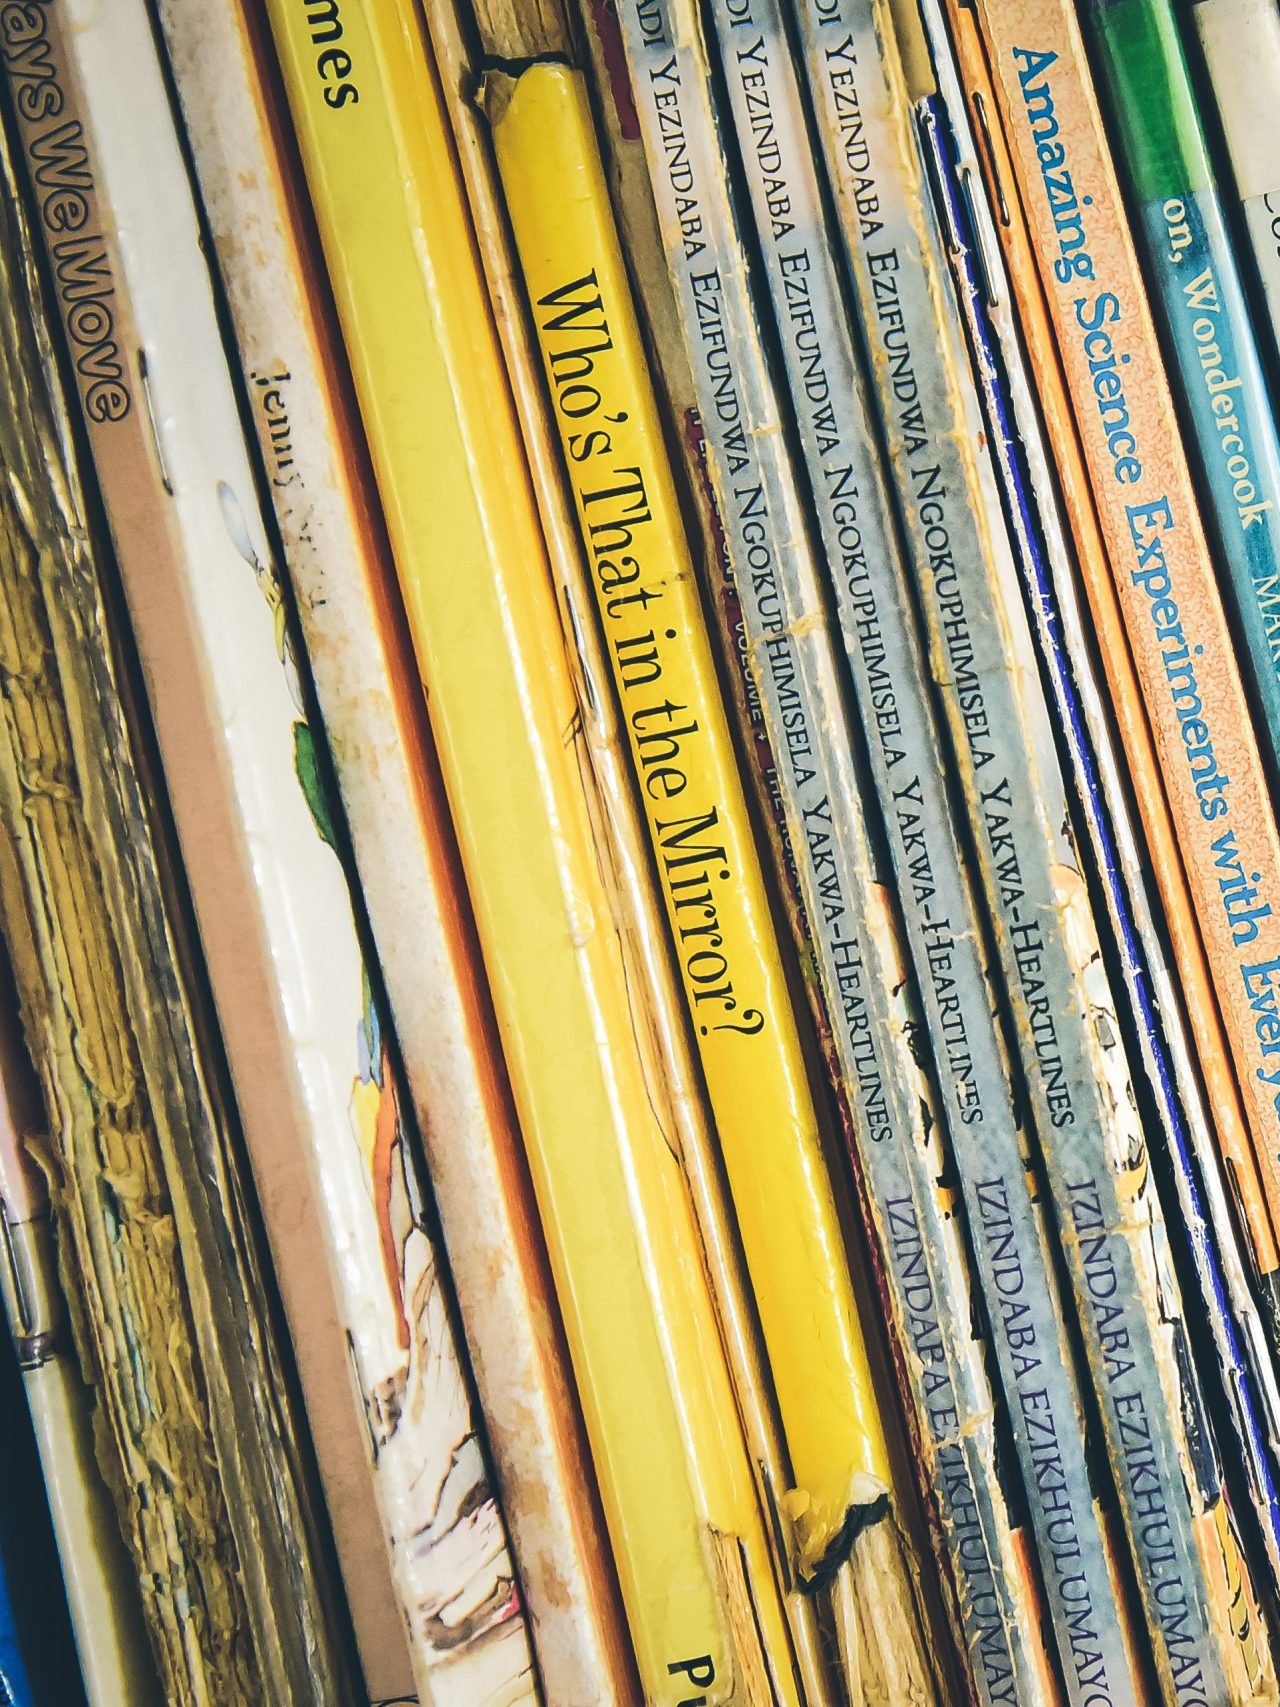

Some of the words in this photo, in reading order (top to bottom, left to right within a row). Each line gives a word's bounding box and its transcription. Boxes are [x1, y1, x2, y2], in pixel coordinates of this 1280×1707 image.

[0, 0, 64, 123] ays
[303, 0, 358, 108] mes
[28, 119, 93, 233] We
[50, 234, 131, 423] Move
[536, 267, 628, 461] Who's
[1183, 267, 1267, 531] Wondercook
[579, 466, 666, 618] That
[648, 54, 706, 261] YEZINDABA
[689, 267, 749, 476] EZIFUNDWA
[733, 482, 816, 787] NGOKUPHIMISELA
[801, 794, 892, 1142] YAKWA-HEARTLINES
[735, 35, 795, 241] YEZINDABA
[777, 247, 840, 456] EZIFUNDWA
[823, 463, 906, 769] NGOKUPHIMISELA
[891, 774, 983, 1124] YAKWA-HEARTLINES
[824, 33, 883, 240] YEZINDABA
[866, 247, 928, 456] EZIFUNDWA
[910, 463, 995, 770] NGOKUPHIMISELA
[979, 777, 1074, 1127] YAKWA-HEARTLINES
[1012, 47, 1096, 284] Amazing
[1073, 292, 1142, 484] Science
[1124, 496, 1230, 821] Experiments
[1210, 830, 1272, 946] with
[614, 628, 676, 691] in
[631, 699, 698, 800] the
[654, 805, 764, 1036] Mirror?
[884, 1193, 951, 1397] IZINDABA
[973, 1175, 1042, 1380] IZINDABA
[1065, 1177, 1135, 1384] IZINDABA
[1112, 1391, 1209, 1707] EZIKHULUMAY
